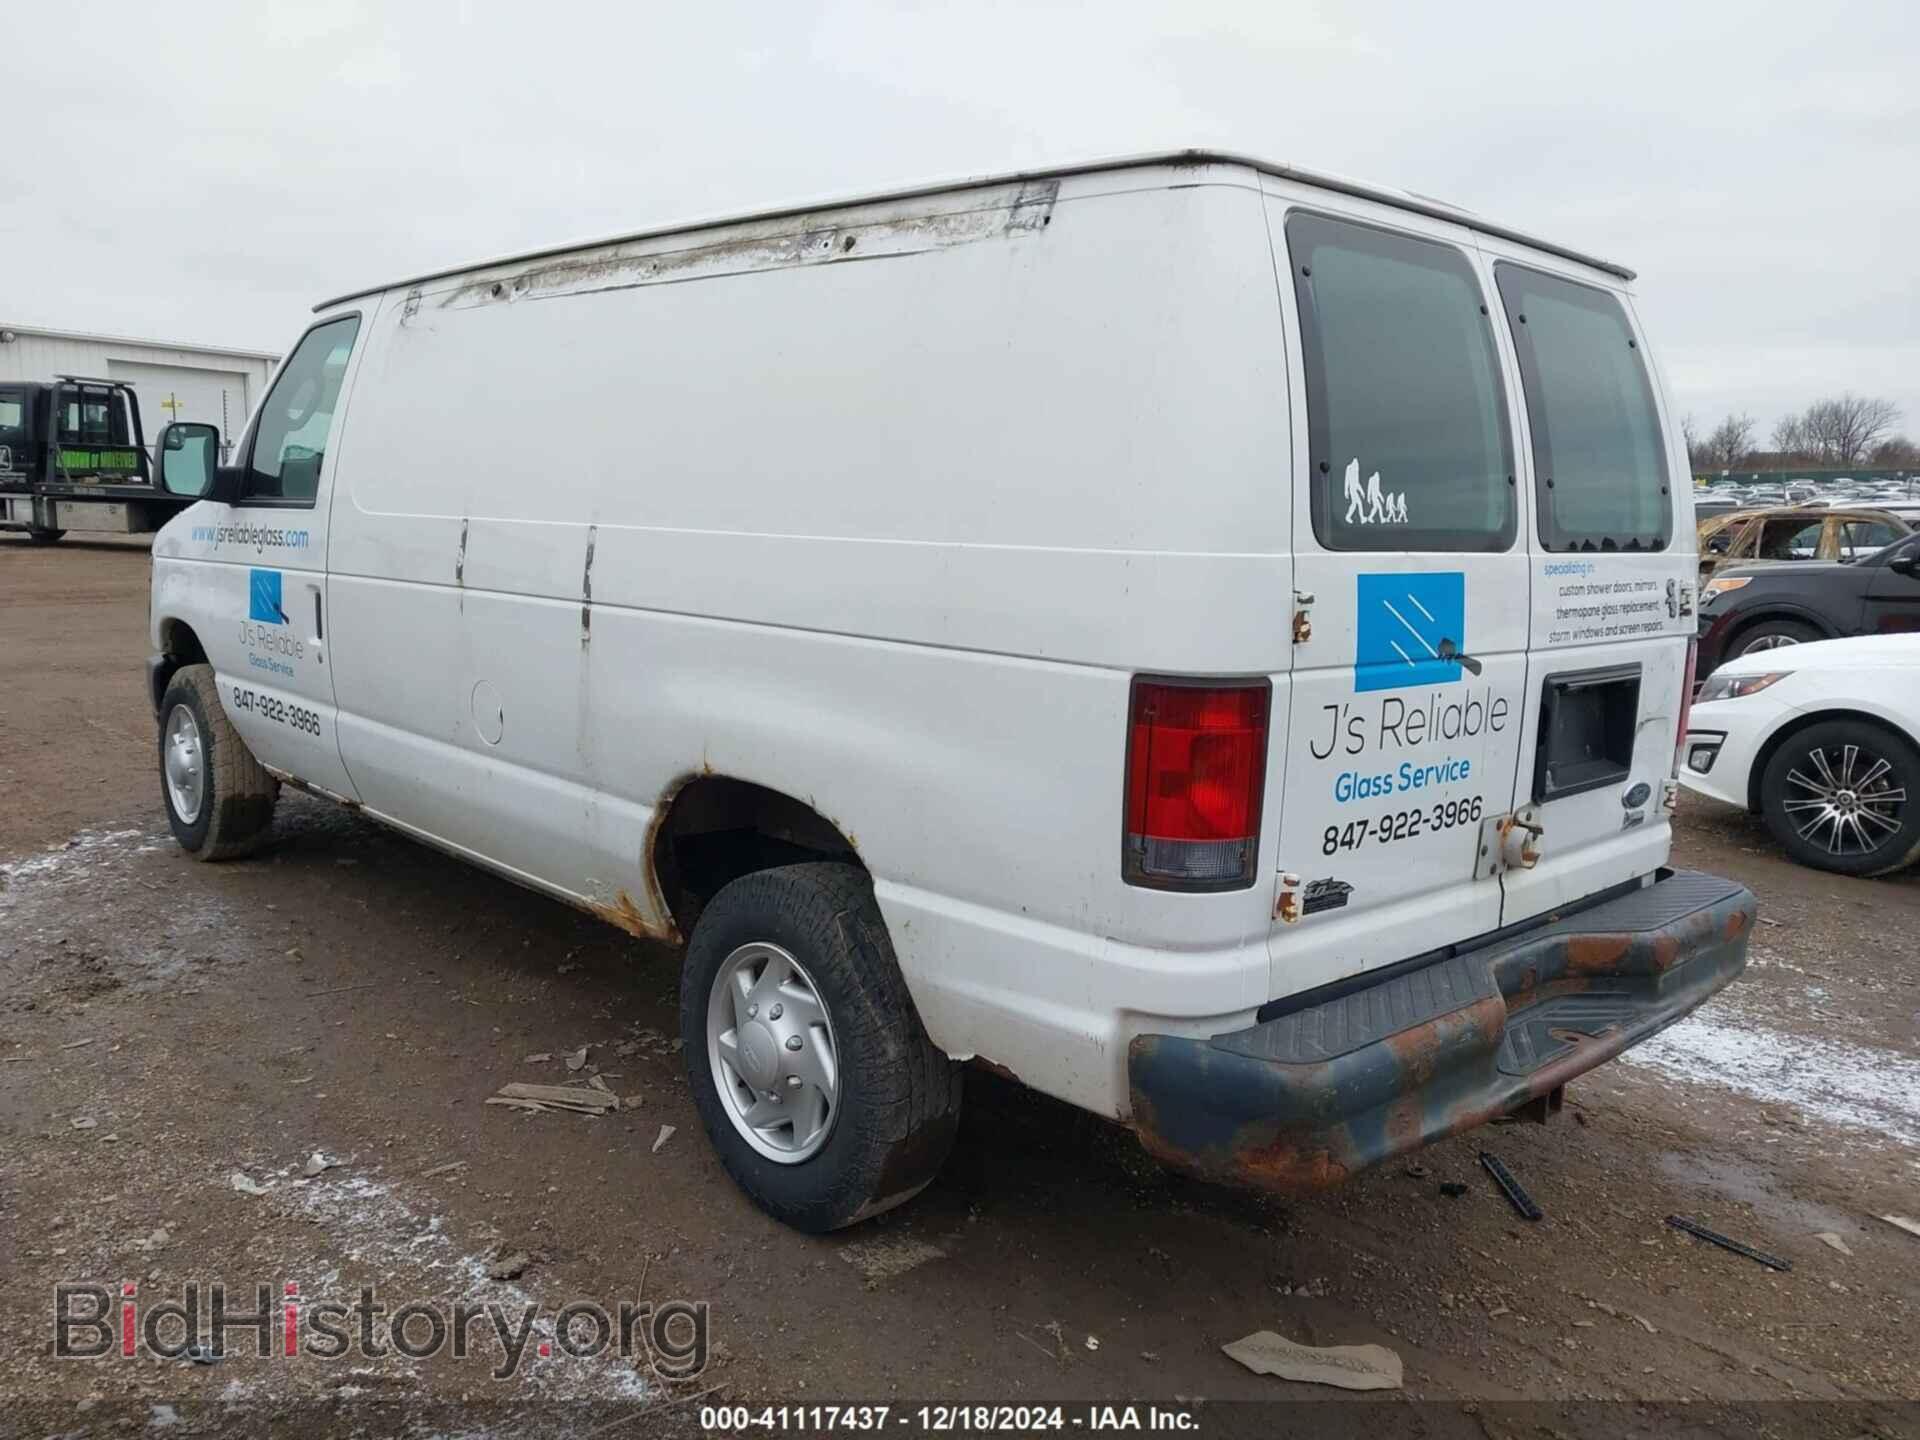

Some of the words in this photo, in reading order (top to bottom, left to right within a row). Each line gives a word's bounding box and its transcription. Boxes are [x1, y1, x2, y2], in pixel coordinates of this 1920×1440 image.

[191, 521, 309, 554] www.jsreliableglass.com
[1559, 584, 1585, 597] custom
[1586, 581, 1613, 595] shower
[1601, 602, 1618, 621] glass
[256, 624, 304, 660] Reliable
[1548, 629, 1571, 643] storm
[1572, 626, 1604, 641] windows
[1605, 622, 1618, 637] and
[1619, 621, 1640, 635] screen
[233, 686, 321, 737] 847-922-3966
[1310, 703, 1365, 760] J's
[1380, 686, 1508, 750] Reliable
[1335, 771, 1393, 803] Glass
[1398, 756, 1470, 792] Service
[1322, 795, 1484, 857] 847-922-3966
